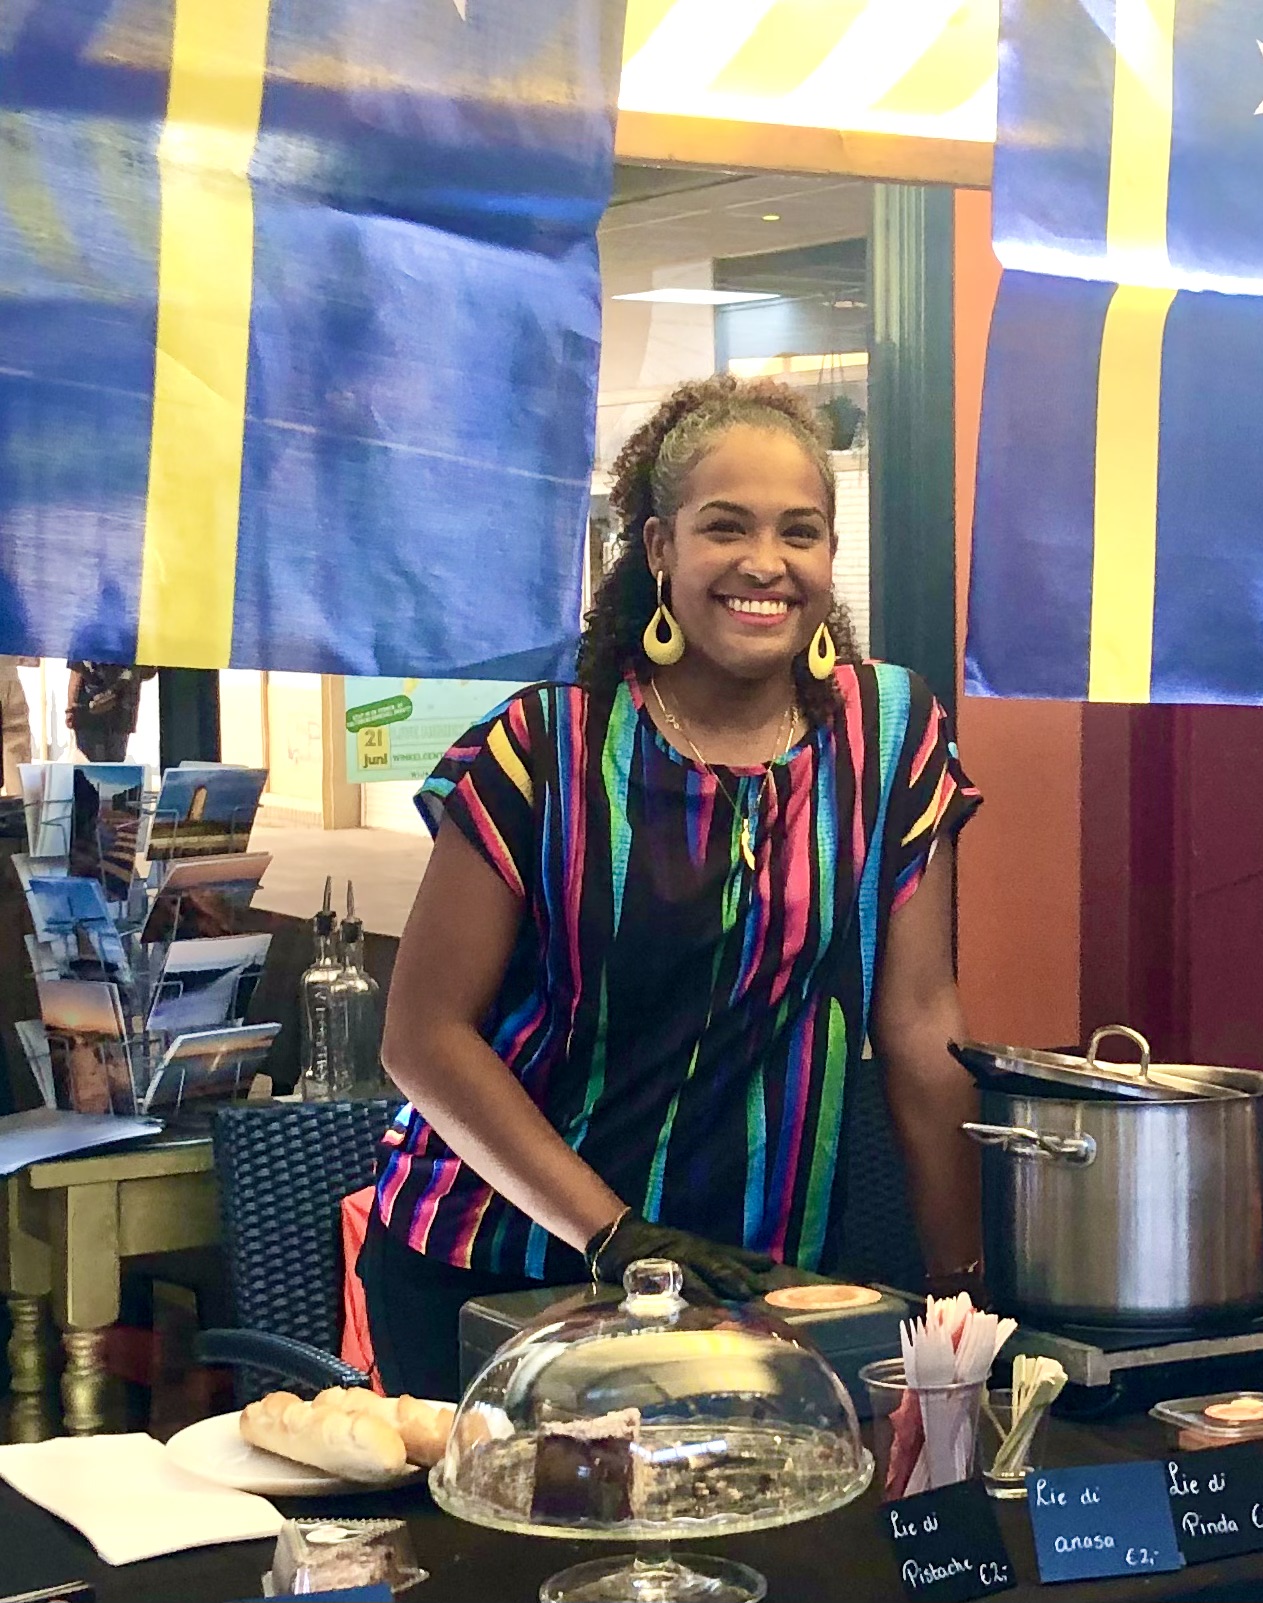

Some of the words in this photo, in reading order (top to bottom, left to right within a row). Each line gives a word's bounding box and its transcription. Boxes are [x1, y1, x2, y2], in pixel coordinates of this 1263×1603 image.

[364, 728, 383, 747] 21
[392, 751, 444, 762] WINKELCENT
[1208, 1472, 1226, 1492] di
[1080, 1487, 1101, 1505] di
[923, 1511, 939, 1532] di
[1182, 1511, 1239, 1536] Pinda
[902, 1557, 974, 1588] Pistache
